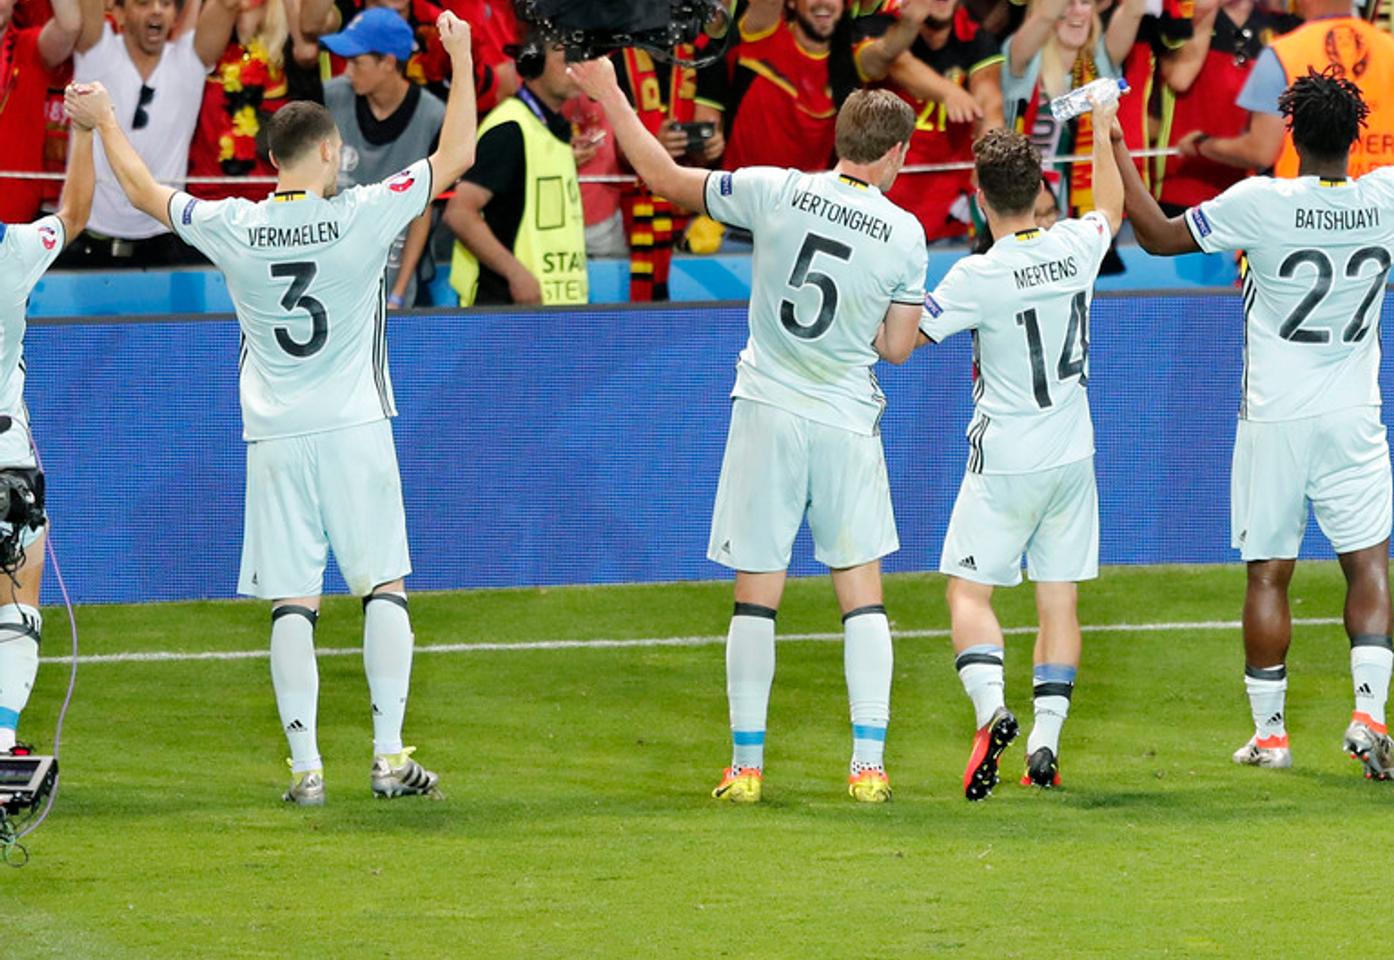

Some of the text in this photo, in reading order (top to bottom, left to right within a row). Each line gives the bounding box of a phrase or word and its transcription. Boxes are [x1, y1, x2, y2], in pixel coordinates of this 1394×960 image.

[247, 221, 341, 248] VERMAELEN
[790, 187, 893, 243] VERTONGHEN
[1295, 207, 1380, 231] BATSHUAYI
[542, 251, 584, 273] STA
[779, 231, 852, 340] 5
[1013, 255, 1079, 290] MERTENS
[269, 261, 329, 358] 3
[1278, 245, 1392, 344] 22
[1015, 290, 1091, 409] 14
